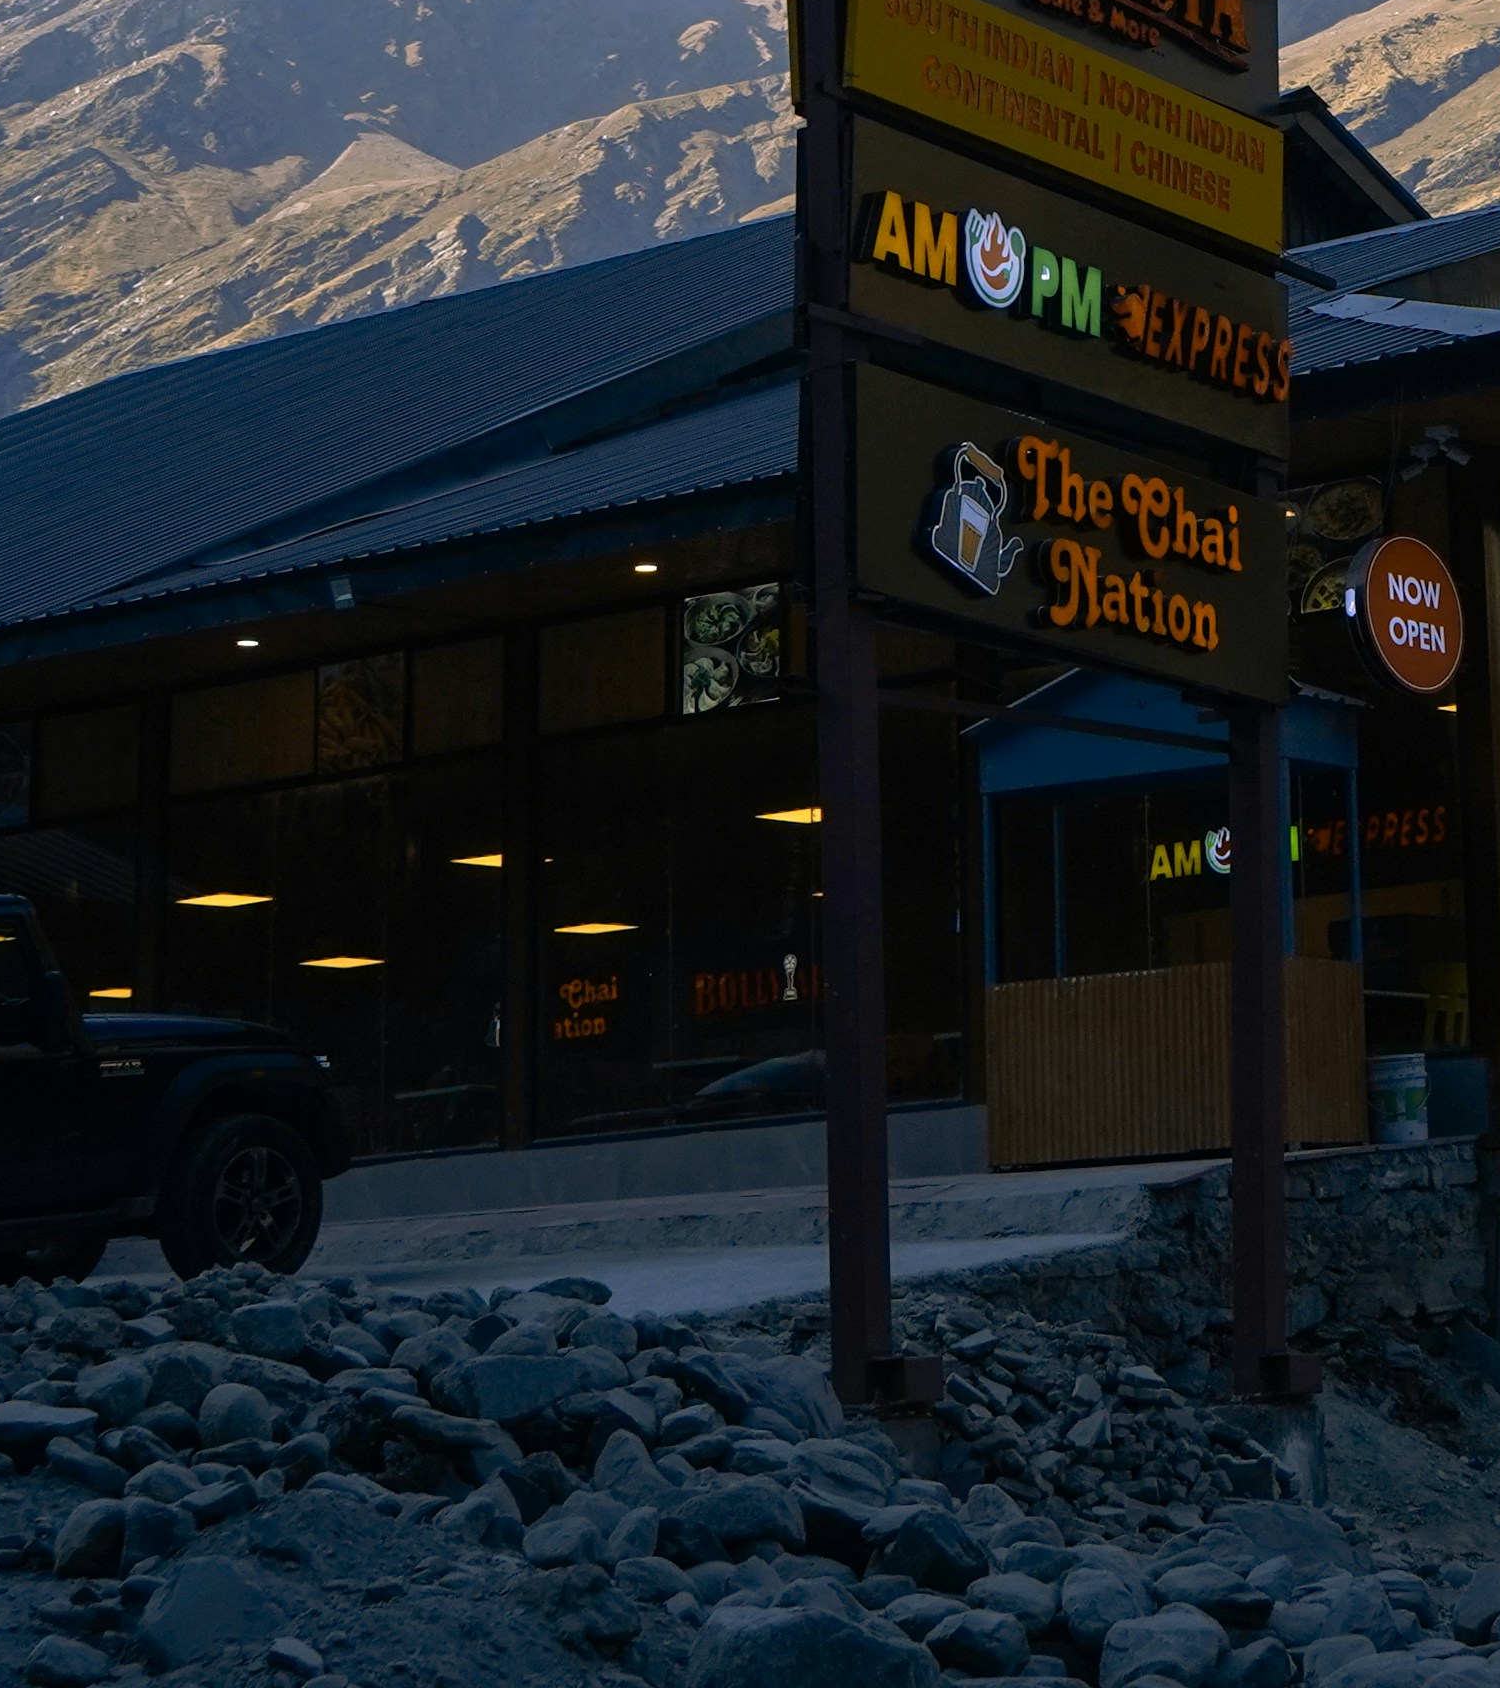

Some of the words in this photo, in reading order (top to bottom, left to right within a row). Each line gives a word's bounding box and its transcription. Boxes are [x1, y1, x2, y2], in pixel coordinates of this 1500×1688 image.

[921, 55, 1105, 160] CONTINENTAL
[1130, 140, 1232, 211] CHINESE
[984, 20, 1075, 92] INDIAN
[1100, 70, 1181, 138] NORTH
[1186, 108, 1266, 174] INDIAN
[872, 190, 958, 287] AM
[1031, 245, 1102, 337] PM
[1144, 288, 1291, 402] EXPRESS
[1017, 434, 1113, 529] The
[1121, 473, 1243, 573] Chai
[1049, 537, 1220, 652] Nation
[1388, 572, 1441, 609] NOW
[1388, 616, 1446, 654] OPEN
[1150, 838, 1202, 882] AM
[1332, 805, 1446, 855] EPRESS
[554, 1011, 607, 1040] ation
[559, 974, 620, 1010] Chai
